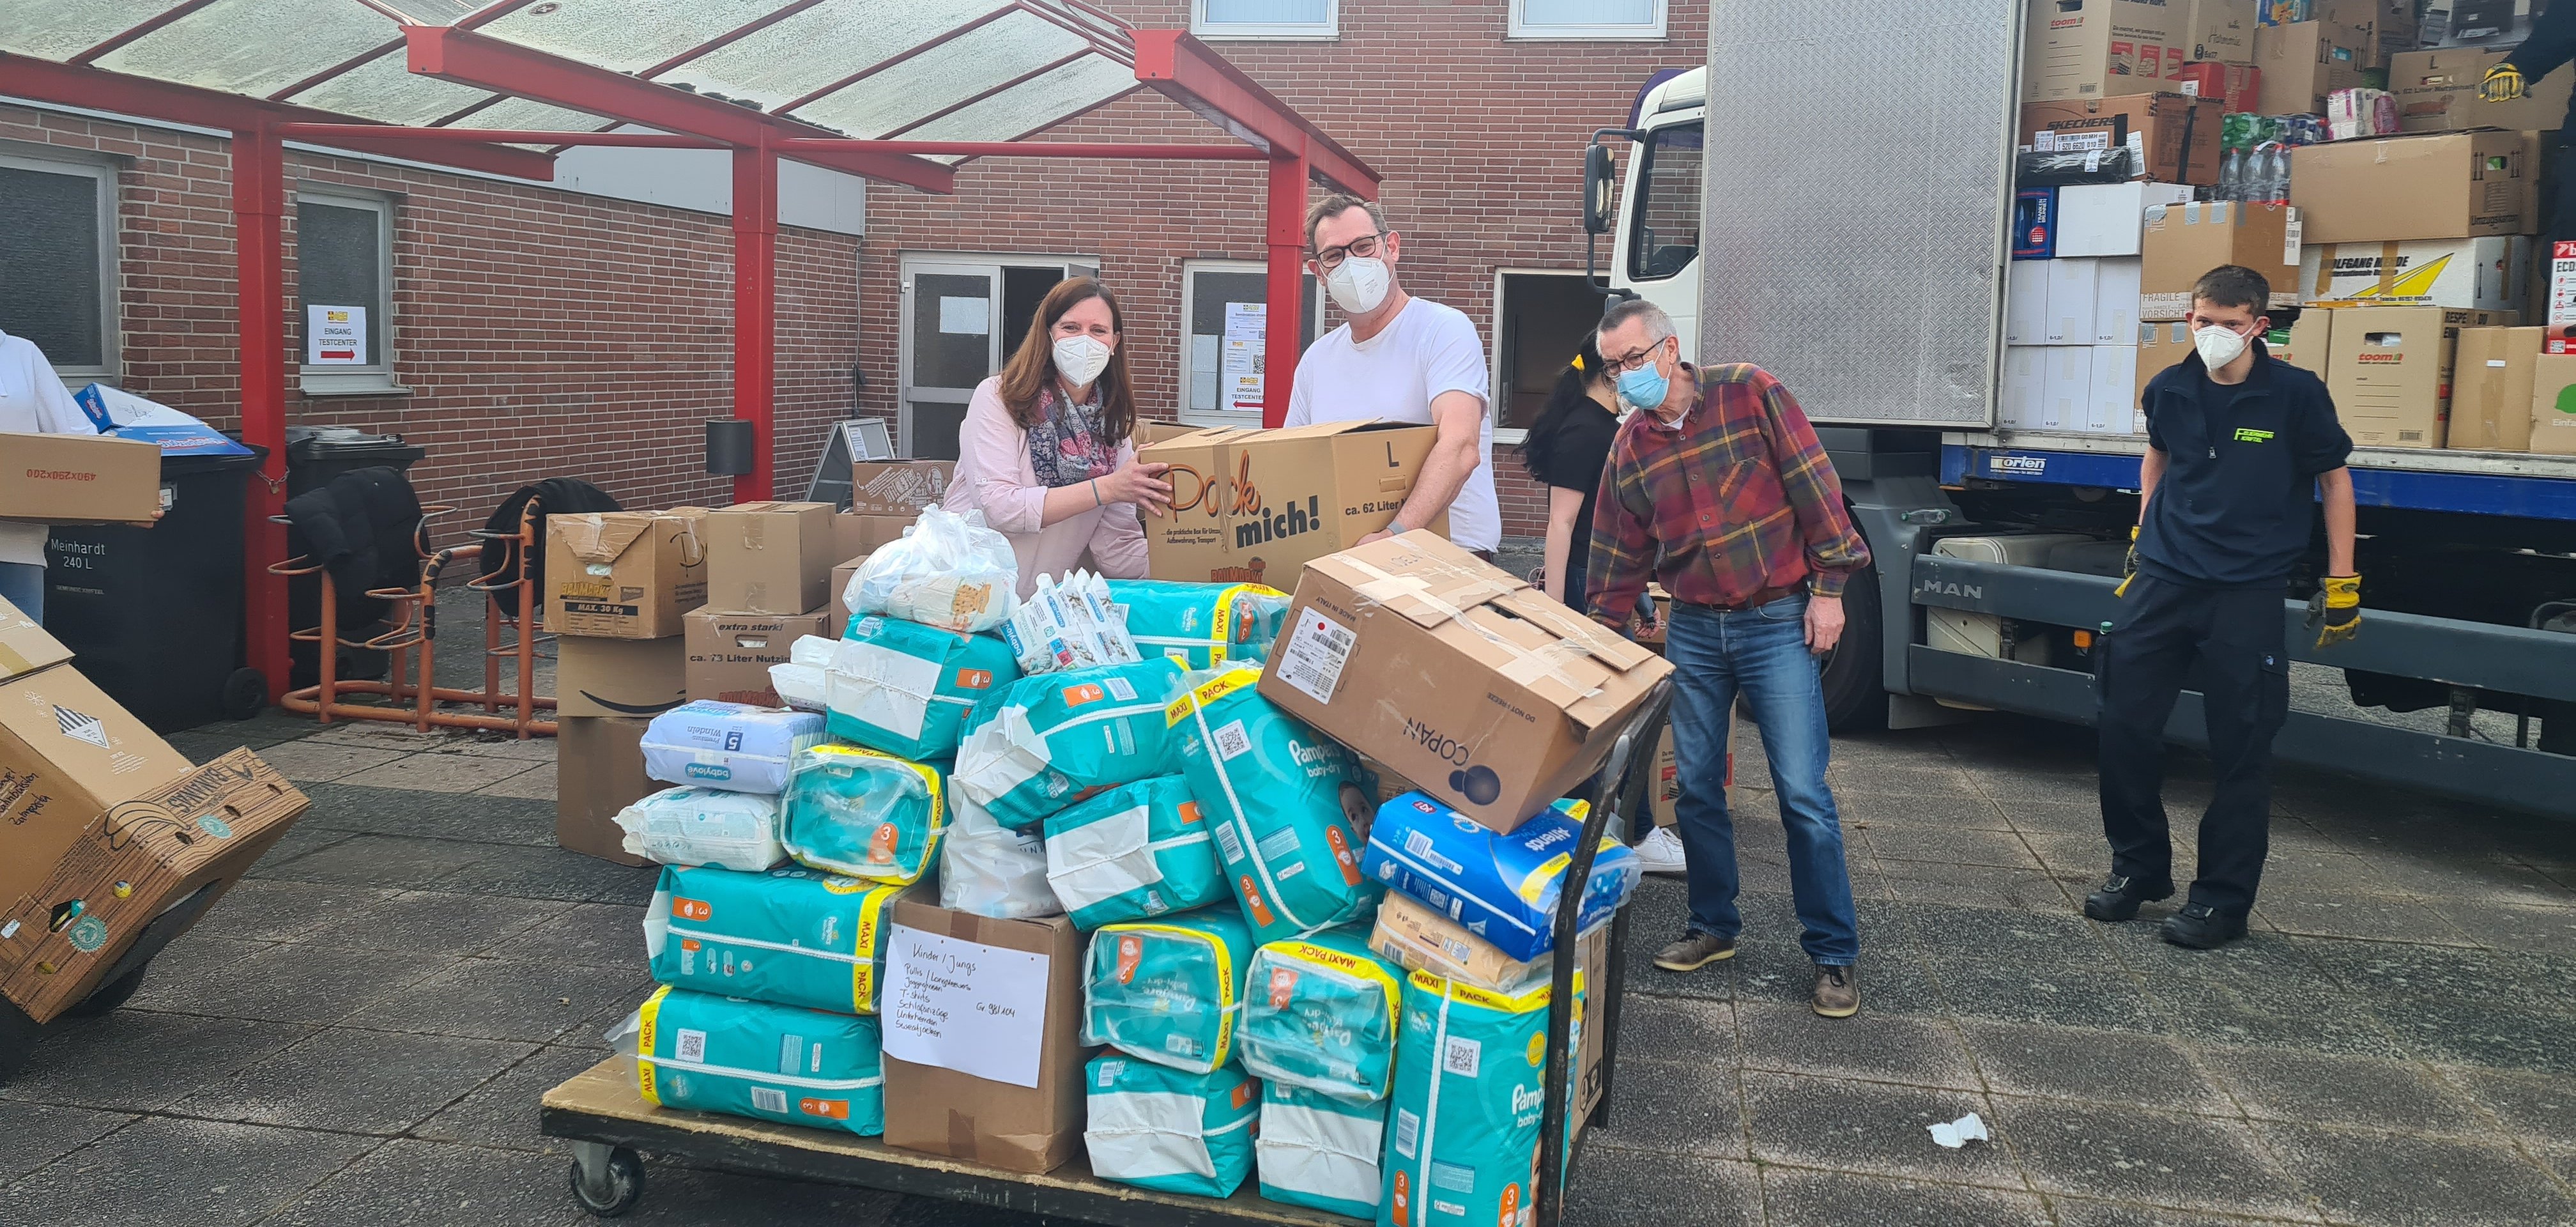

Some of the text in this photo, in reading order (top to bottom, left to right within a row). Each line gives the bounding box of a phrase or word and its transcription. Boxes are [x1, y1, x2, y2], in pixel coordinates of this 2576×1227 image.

[2051, 18, 2076, 26] toom
[2046, 117, 2115, 130] SKECHERS
[2143, 293, 2181, 302] FRAGILE
[2142, 309, 2185, 319] VORSICHT
[2359, 353, 2393, 361] toom
[1386, 441, 1399, 468] L
[1346, 505, 1360, 516] ca.
[1363, 502, 1375, 513] 62
[1377, 500, 1399, 511] Liter
[1236, 495, 1321, 549] mich!
[51, 539, 105, 555] Meinhardt
[63, 556, 93, 569] 240 L
[1923, 580, 1982, 599] MAN
[578, 603, 597, 612] MAX.
[613, 606, 624, 615] Kg
[1315, 596, 1332, 608] ITALY
[1216, 609, 1225, 633] MAXI
[1338, 608, 1356, 622] MADE
[719, 622, 784, 633] extra stark!
[690, 654, 706, 663] ca.
[727, 654, 753, 663] Liter
[1170, 681, 1229, 720] MAXI PACK
[1487, 692, 1536, 723] DO NOT FREEZE
[687, 725, 721, 737] Windeln
[728, 736, 739, 750] 5
[1403, 716, 1469, 766] COPAN
[1288, 739, 1340, 766] Pampers
[687, 765, 730, 778] babylove
[1307, 764, 1340, 778] baby-dry
[167, 766, 229, 814] BANANAS
[880, 826, 892, 841] 3
[1332, 830, 1341, 844] 3
[1243, 879, 1251, 890] 3
[698, 907, 709, 916] 3
[859, 921, 871, 950] MAXI
[912, 943, 939, 961] Kinder
[946, 955, 976, 976] Jungs
[1300, 945, 1356, 969] MAXI PACK
[858, 971, 868, 998] PACK
[1414, 973, 1491, 1004] MAXI PACK
[643, 1019, 652, 1048] PACK
[1220, 1021, 1230, 1049] MAXI
[643, 1068, 653, 1093] MAXI
[802, 1102, 814, 1110] 3
[1512, 1083, 1545, 1115] Pamp
[1399, 1175, 1405, 1187] 3
[1506, 1188, 1515, 1205] 3
